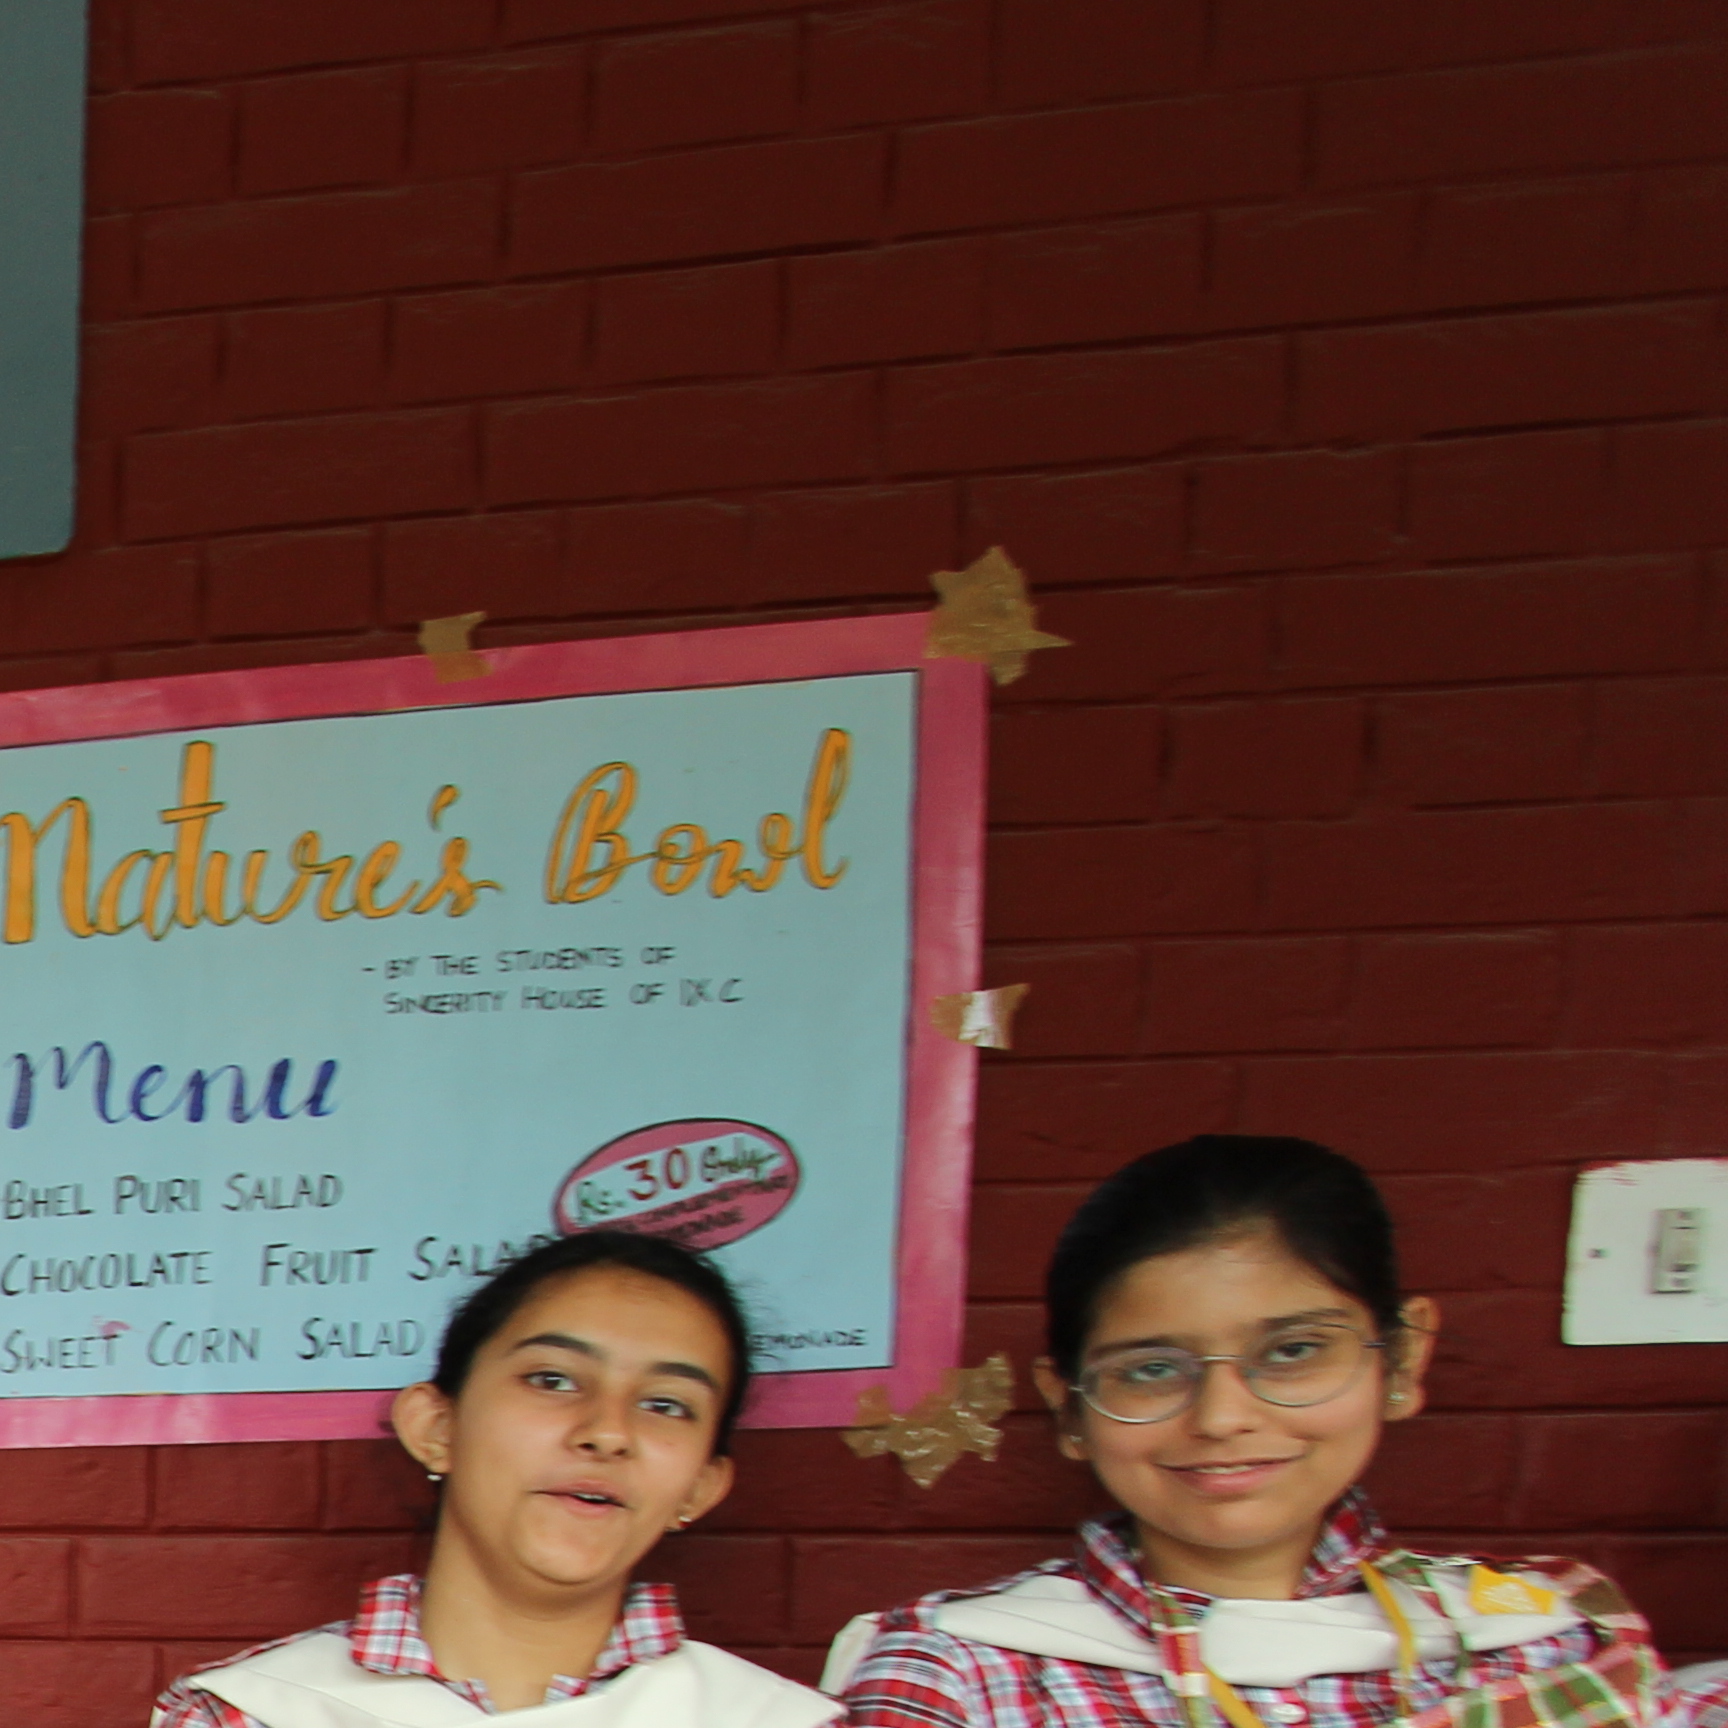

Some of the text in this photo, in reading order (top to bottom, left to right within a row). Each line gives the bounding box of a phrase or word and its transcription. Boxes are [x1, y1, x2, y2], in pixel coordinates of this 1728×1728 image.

[545, 728, 852, 904] Bowl
[383, 956, 421, 980] BY
[428, 954, 480, 976] THE
[496, 947, 625, 972] STUDENTS
[639, 946, 677, 966] OF
[382, 990, 508, 1014] SINCERITY
[520, 985, 609, 1011] HOUSE
[629, 982, 666, 1005] OF
[3, 1040, 341, 1130] Menu
[2, 1172, 344, 1220] BHEL PURI SALAD
[624, 1148, 690, 1201] 30
[259, 1242, 379, 1287] FRUIT
[146, 1320, 261, 1367] CORN
[296, 1316, 426, 1362] SALAD
[746, 1328, 868, 1351] EMONADE
